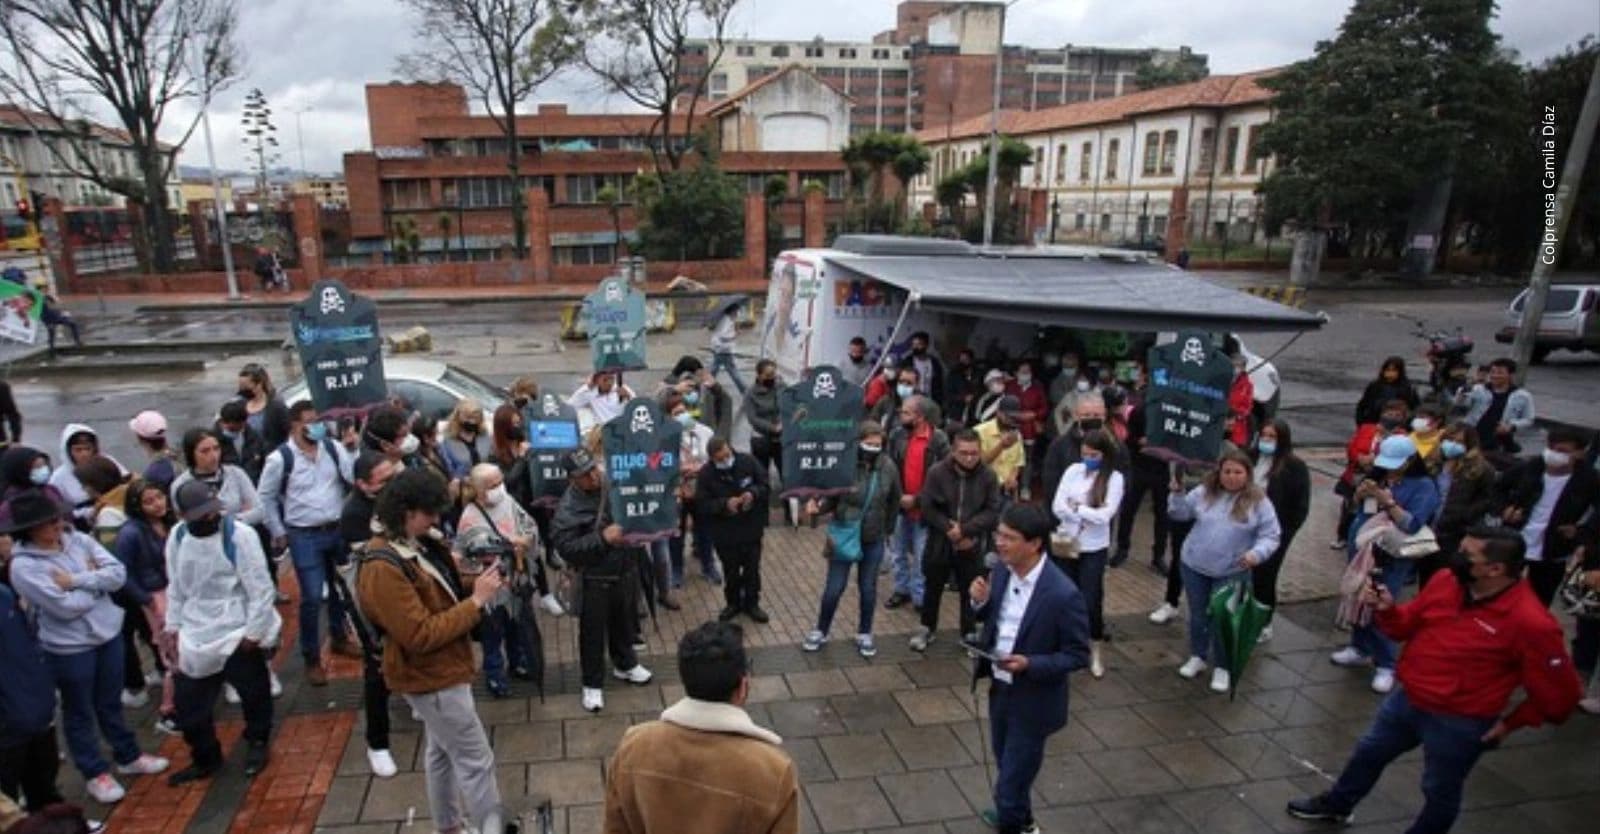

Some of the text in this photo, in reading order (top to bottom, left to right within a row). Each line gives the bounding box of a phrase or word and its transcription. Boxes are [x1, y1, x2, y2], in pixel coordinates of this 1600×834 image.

[325, 371, 363, 390] R.I.P
[1164, 418, 1202, 438] R.I.P
[611, 450, 673, 470] nueva
[800, 456, 838, 470] R.I.P
[626, 501, 659, 517] R.I.P
